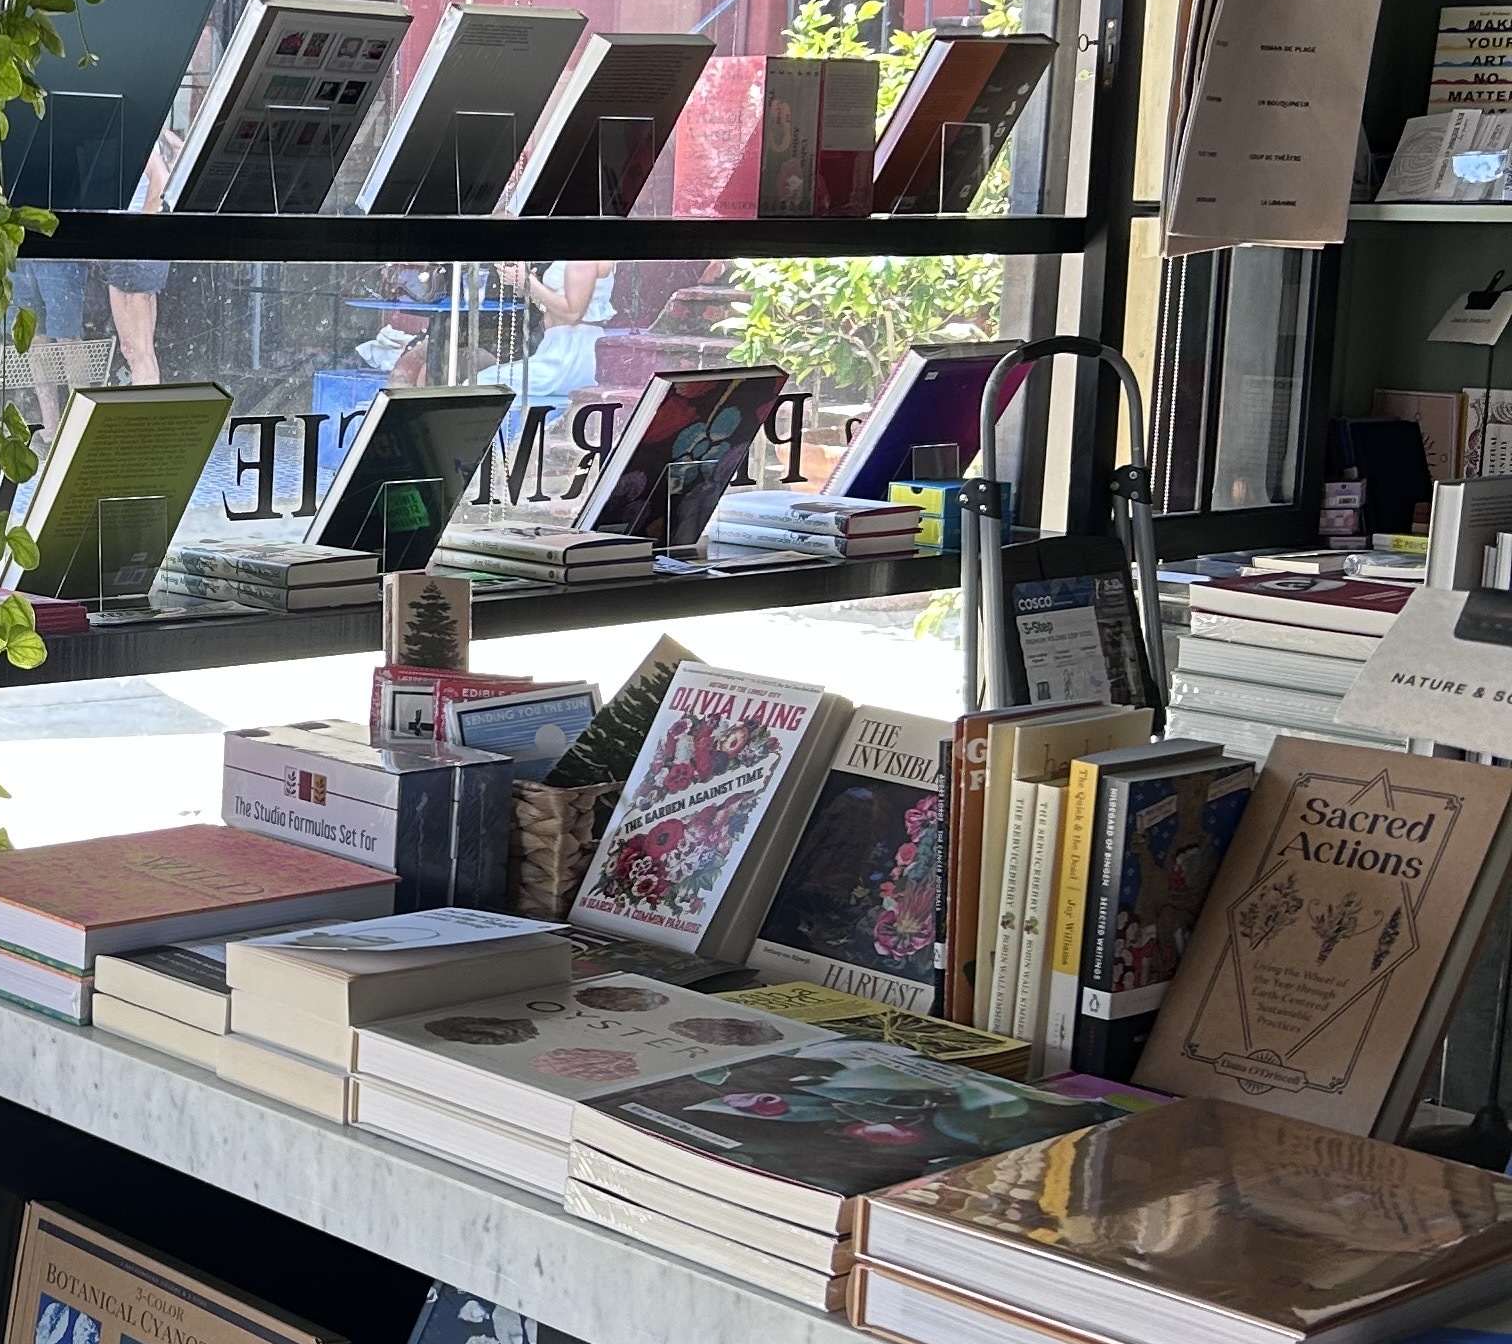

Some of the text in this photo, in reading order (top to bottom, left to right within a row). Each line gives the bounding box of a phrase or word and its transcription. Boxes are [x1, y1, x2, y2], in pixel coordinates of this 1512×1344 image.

[1468, 55, 1507, 67] ART
[1473, 73, 1499, 84] NO
[1018, 595, 1052, 611] COSCO
[1022, 622, 1054, 635] 3-Step
[1391, 672, 1486, 699] NATURE &
[463, 698, 588, 727] SENDING YOU THE SUN
[668, 686, 807, 732] OLIVIA LAING
[857, 718, 903, 750] THE
[1077, 768, 1088, 784] The
[624, 767, 764, 834] THE GARDEN AGAINST TIME
[1074, 786, 1087, 823] Quick
[1107, 788, 1118, 839] HILDEGARD
[234, 796, 378, 852] The Studio Formulas Set for
[1300, 798, 1436, 844] Sacred
[1069, 850, 1082, 882] Dead
[1277, 832, 1424, 880] Actions
[1062, 898, 1078, 966] Joy Williams
[1092, 896, 1108, 981] SELECTED WRITINGS
[822, 964, 926, 1012] HARVEST
[46, 1262, 136, 1326] BOTANICAL
[136, 1286, 185, 1323] 3-COLOR
